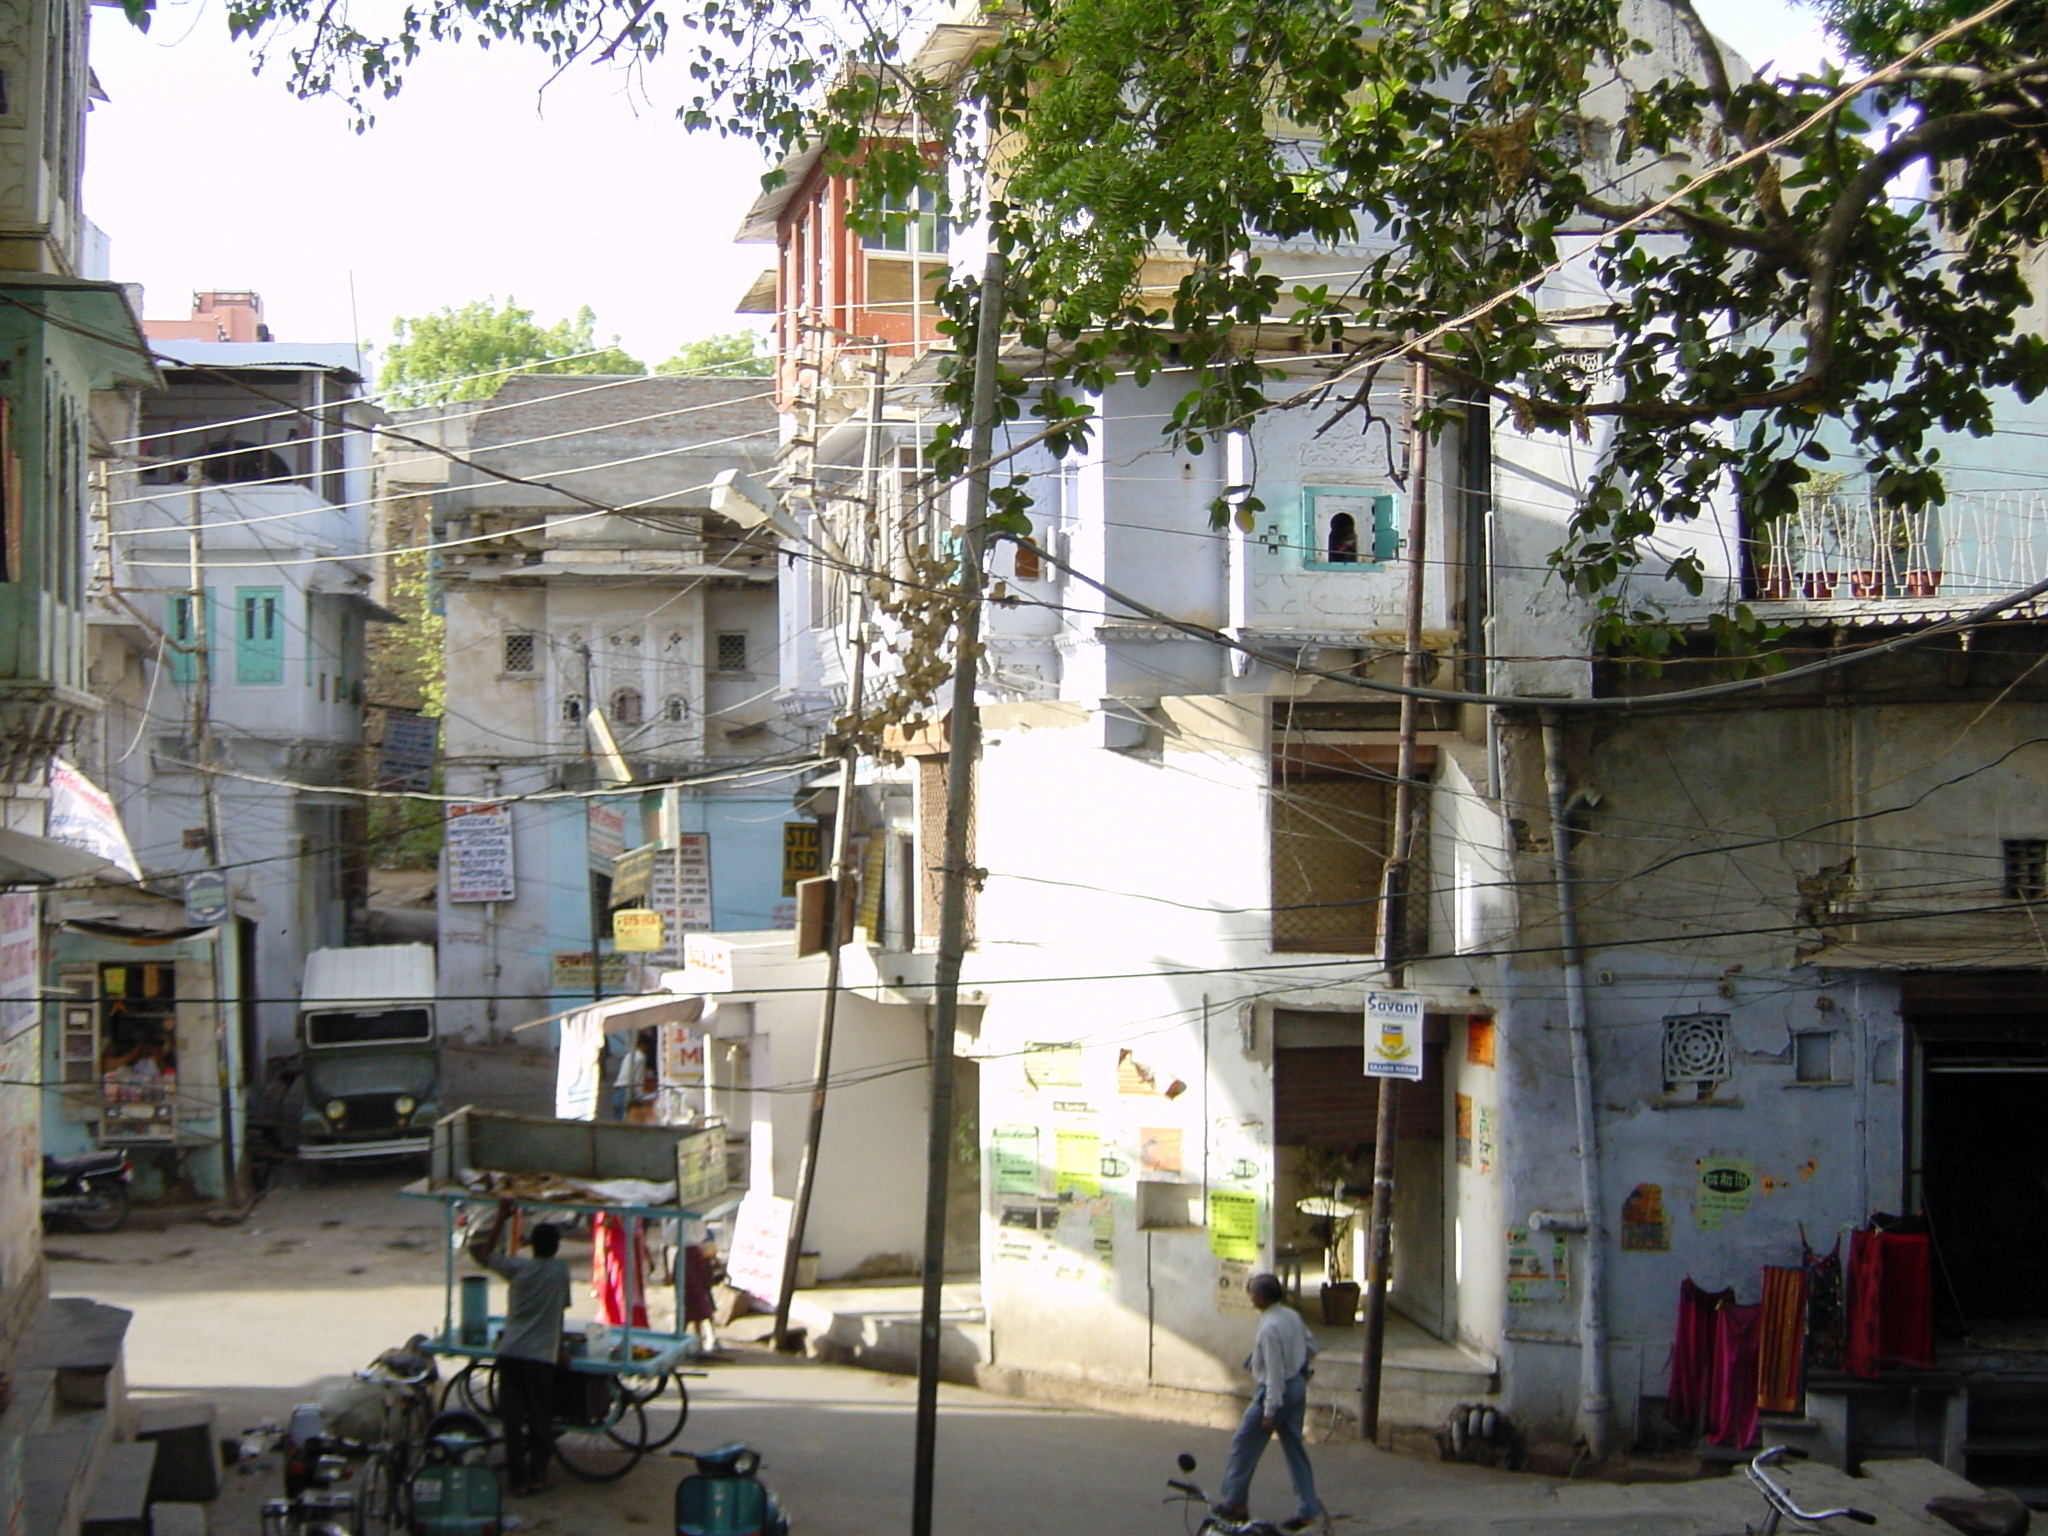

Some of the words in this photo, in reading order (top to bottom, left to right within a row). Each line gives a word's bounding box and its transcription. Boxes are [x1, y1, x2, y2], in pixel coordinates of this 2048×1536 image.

[459, 817, 496, 826] SUZUKI
[786, 826, 819, 846] STD
[460, 859, 506, 868] SCOOTY
[787, 850, 819, 870] ISD
[1368, 993, 1418, 1014] Savant
